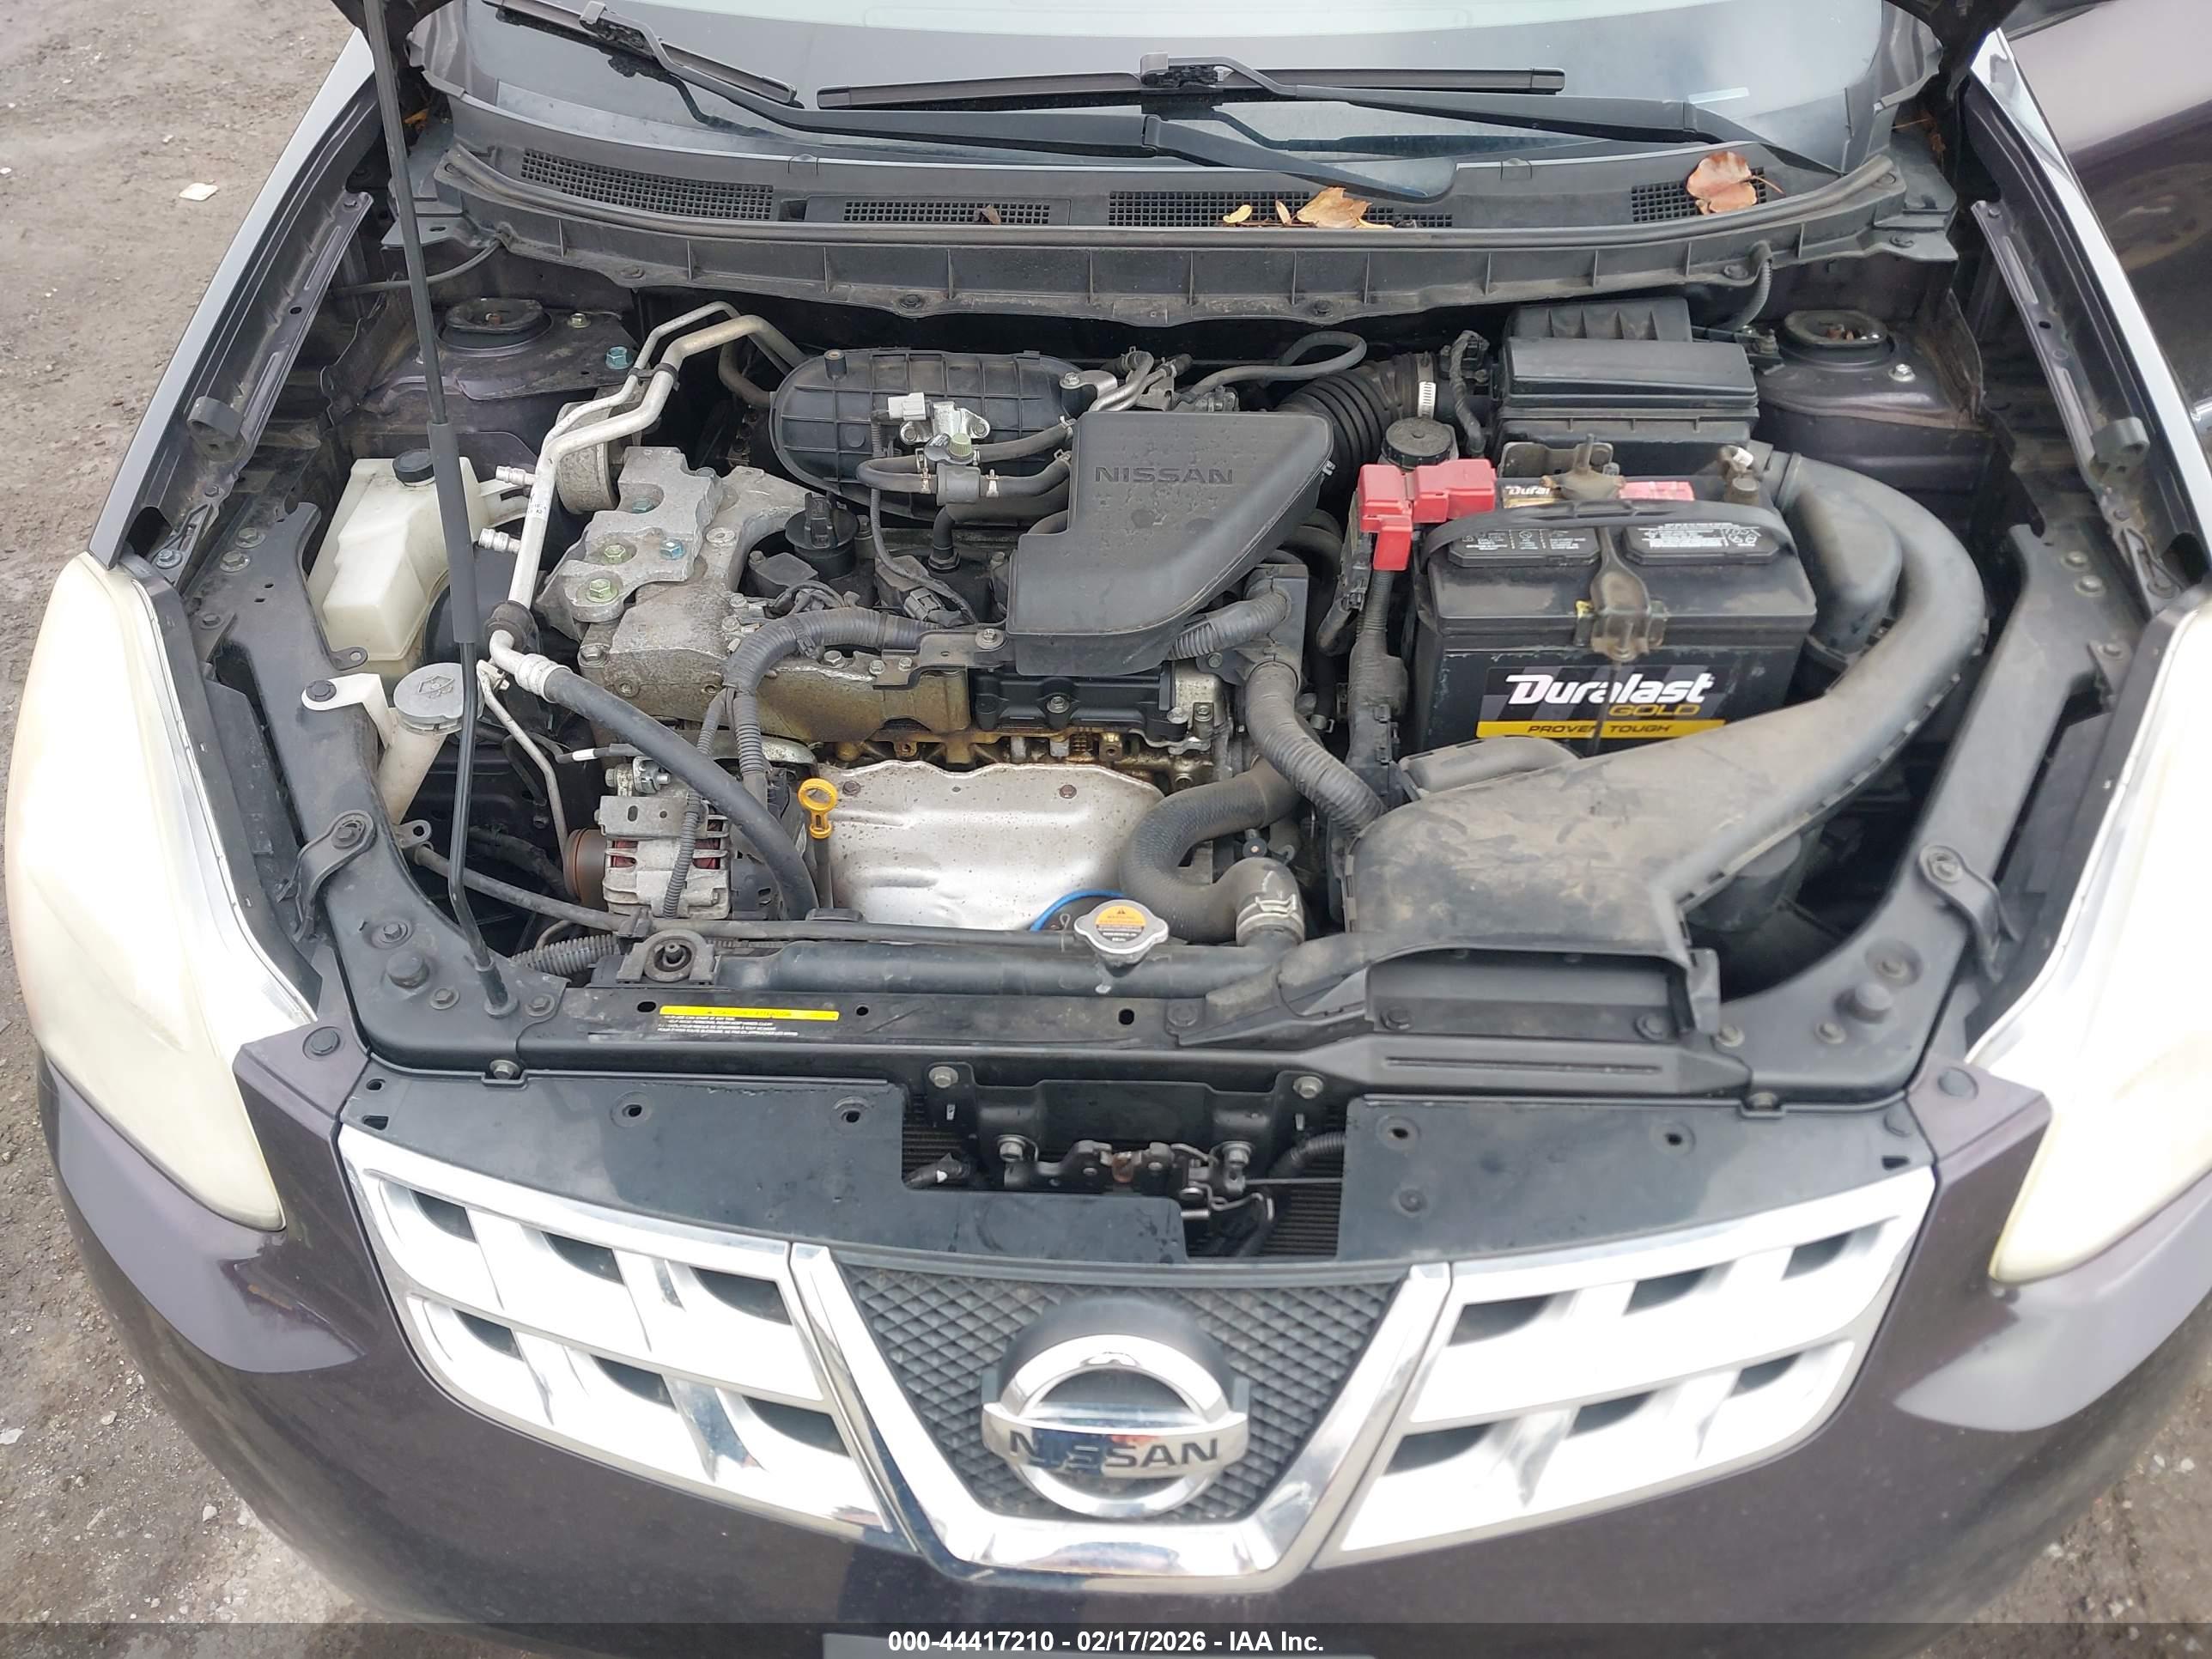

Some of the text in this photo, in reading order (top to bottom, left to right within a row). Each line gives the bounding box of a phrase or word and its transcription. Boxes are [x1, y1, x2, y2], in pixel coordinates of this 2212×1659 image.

[1095, 466, 1233, 484] NISSAN
[1505, 673, 1715, 705] Duralast
[1608, 704, 1701, 717] GOLD
[1609, 724, 1672, 733] TOUGH
